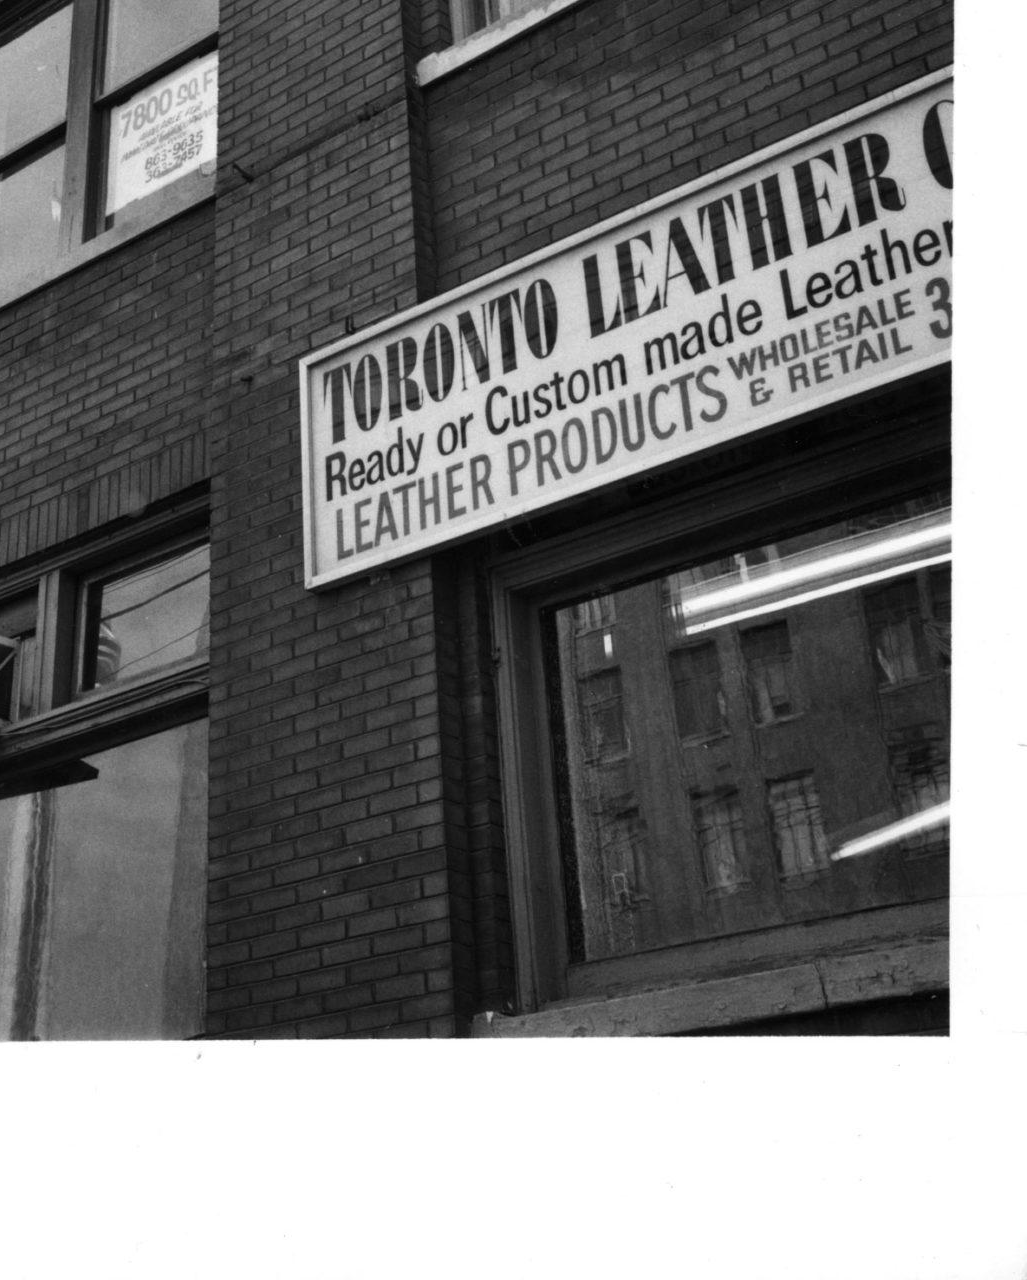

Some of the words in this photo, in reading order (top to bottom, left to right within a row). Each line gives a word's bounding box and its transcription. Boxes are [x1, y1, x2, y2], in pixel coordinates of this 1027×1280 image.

[121, 88, 172, 138] 7800
[203, 67, 218, 93] F
[323, 278, 558, 444] TORONTO
[582, 132, 906, 339] LEATHER
[728, 289, 915, 382] WHOLESALE
[325, 426, 424, 502] Ready
[437, 412, 474, 456] or
[484, 354, 627, 435] Custom
[644, 298, 763, 376] made
[750, 377, 775, 406] &
[789, 327, 912, 393] RETAIL
[335, 454, 495, 561] LEATHER
[507, 365, 728, 497] PRODUCTS
